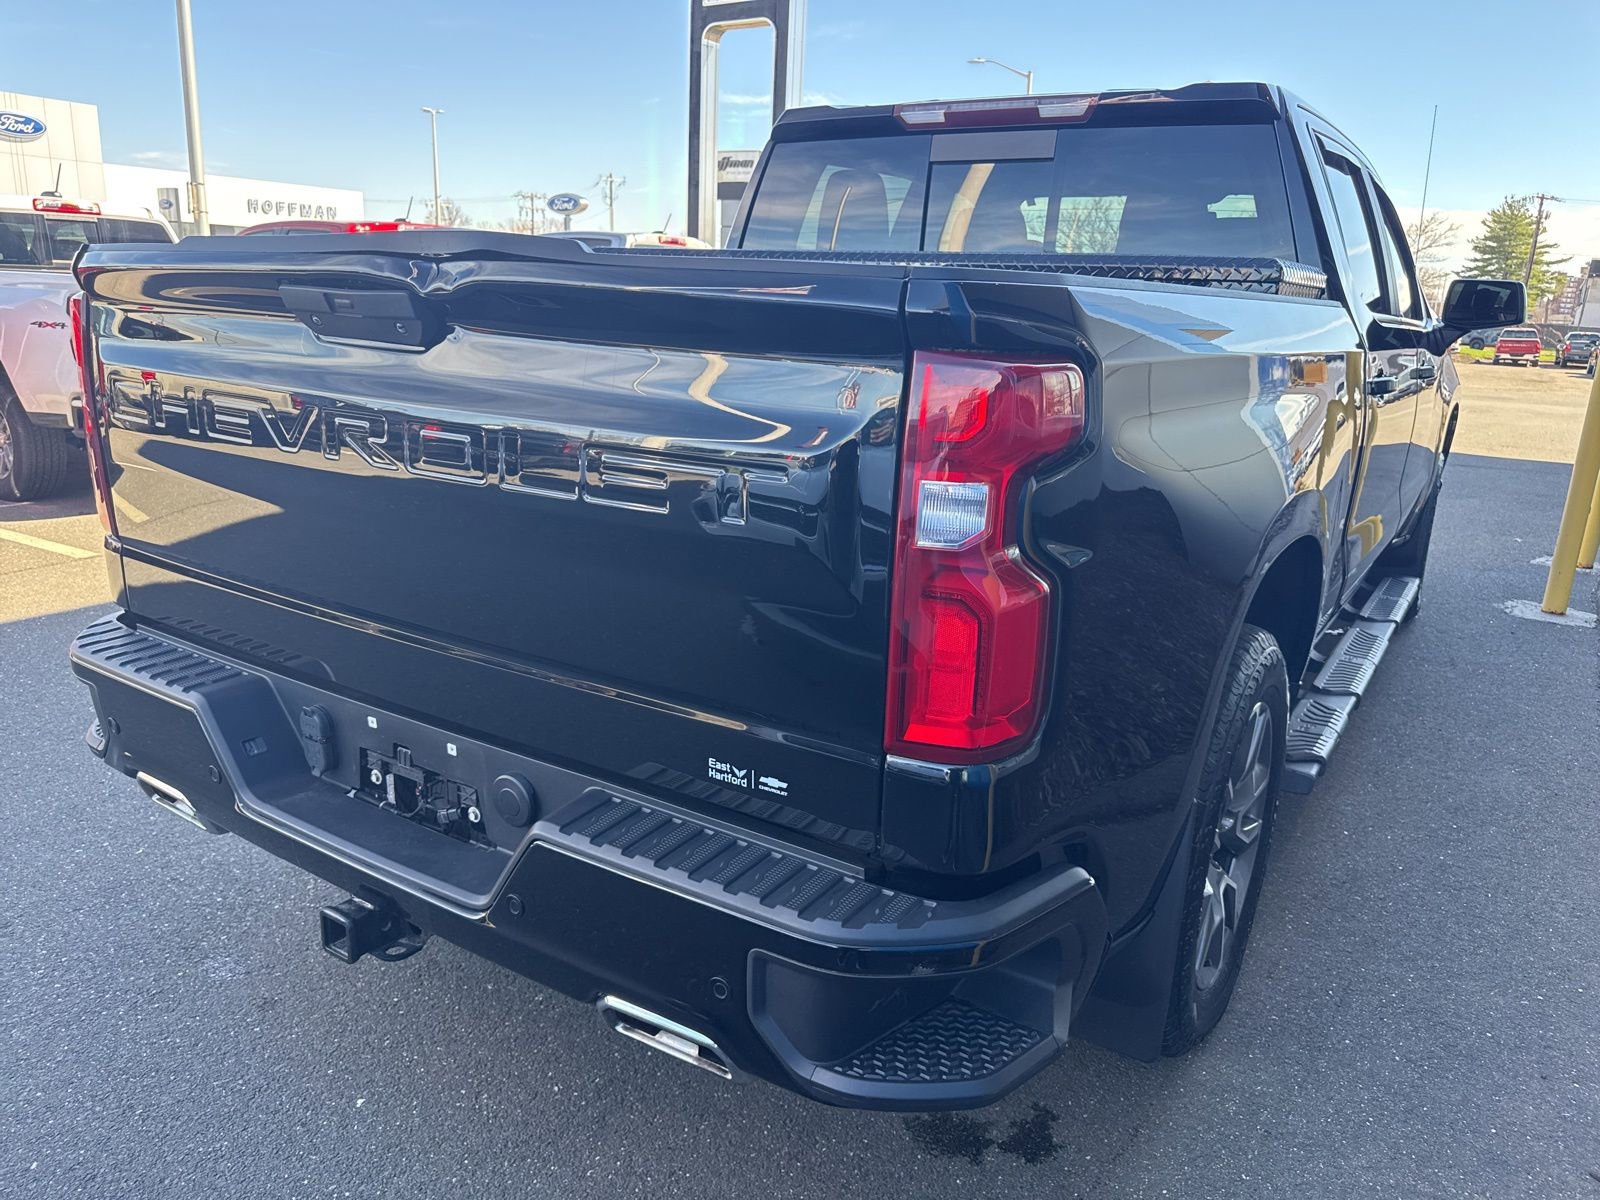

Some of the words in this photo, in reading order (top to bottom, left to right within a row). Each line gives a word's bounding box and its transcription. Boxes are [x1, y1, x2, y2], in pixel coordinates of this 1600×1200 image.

[0, 114, 35, 134] Ford
[247, 198, 337, 220] HOFFMAN
[552, 197, 575, 211] Ford
[107, 371, 790, 526] CHEVROLET
[708, 757, 731, 772] East
[708, 768, 748, 787] Hartford
[758, 785, 788, 796] CHEVROLET
